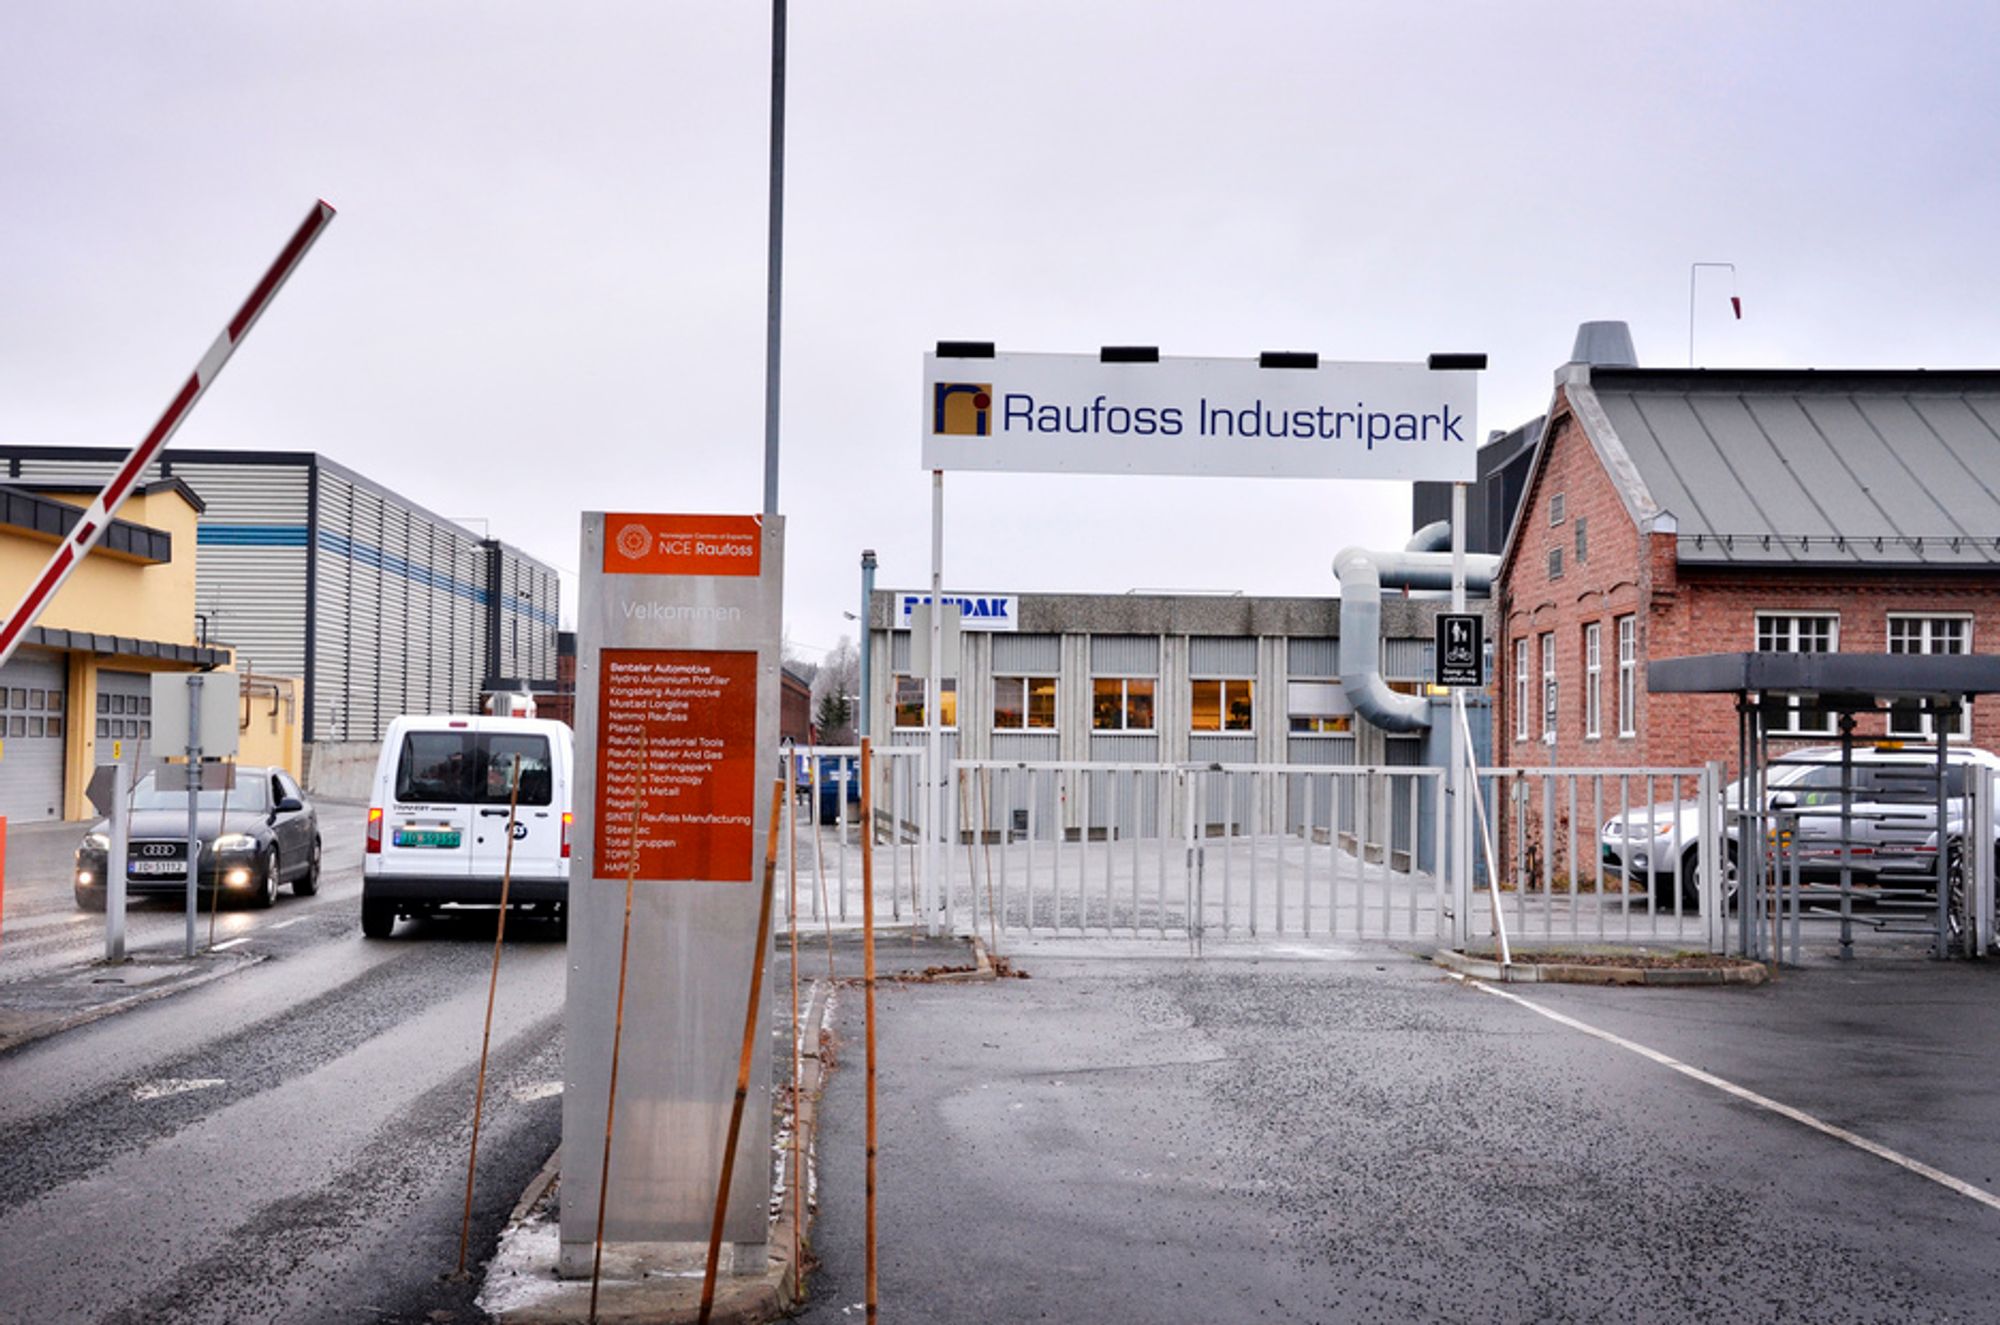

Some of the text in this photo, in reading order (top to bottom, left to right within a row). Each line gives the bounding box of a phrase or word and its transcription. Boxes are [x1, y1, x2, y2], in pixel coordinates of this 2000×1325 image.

[1003, 394, 1465, 450] Raufoss Industripark
[658, 541, 753, 557] NCE Raufoss
[621, 600, 741, 621] Velkommen
[654, 664, 711, 674] Automotive
[610, 674, 640, 684] Hydro
[641, 675, 690, 684] Aluminium
[610, 686, 721, 698] Kongsberg Automotive
[609, 699, 689, 710] Mustad Longline
[609, 711, 688, 722] Nammo Raufoss
[608, 735, 724, 748] Raufos Industrial Tools
[607, 748, 723, 760] Raufos Water And Gas
[607, 761, 647, 771] Raufos
[607, 773, 704, 785] Raufos Technology
[607, 785, 646, 795] Raufos
[641, 812, 680, 823] Raufoss
[682, 814, 751, 826] Manufacturing
